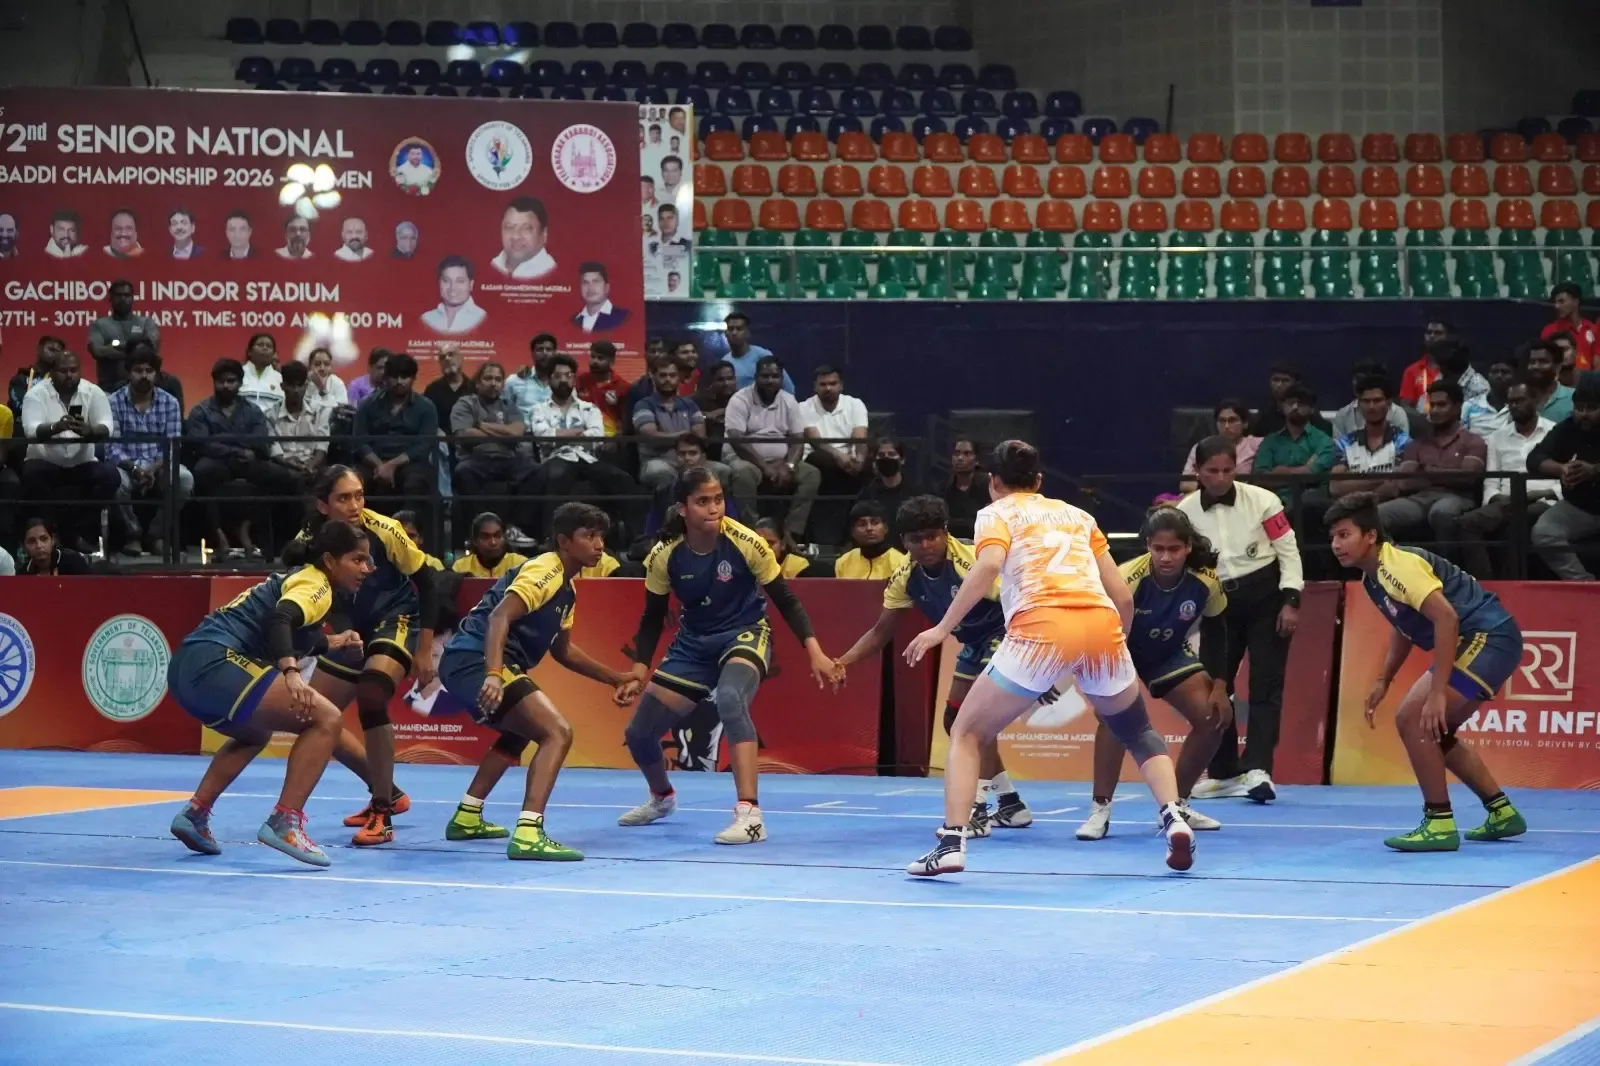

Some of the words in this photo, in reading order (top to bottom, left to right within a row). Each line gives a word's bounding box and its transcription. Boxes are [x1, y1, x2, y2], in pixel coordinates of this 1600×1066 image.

[0, 122, 47, 153] 2nd
[57, 124, 177, 155] SENIOR
[187, 126, 354, 158] NATIONAL
[62, 165, 218, 186] CHAMPIONSHIP
[223, 168, 275, 187] 2026
[4, 280, 145, 301] GACHIBOI
[152, 280, 239, 302] INDOOR
[246, 281, 340, 303] STADIUM
[54, 310, 97, 326] 30TH
[192, 310, 236, 327] TIME:
[240, 311, 286, 328] 10:00
[376, 312, 403, 329] PM
[364, 516, 409, 548] KABADDI
[724, 526, 768, 558] KABADDI
[1042, 531, 1079, 575] 2
[89, 622, 123, 665] GOVERNMENT
[127, 622, 137, 630] OF
[140, 625, 166, 666] TELANGANA
[399, 723, 439, 732] MAHENDAR
[440, 724, 464, 733] REDDY
[1539, 711, 1600, 735] INF
[1479, 739, 1491, 747] BY
[1537, 740, 1574, 749] DRIVEN
[1578, 741, 1591, 749] BY
